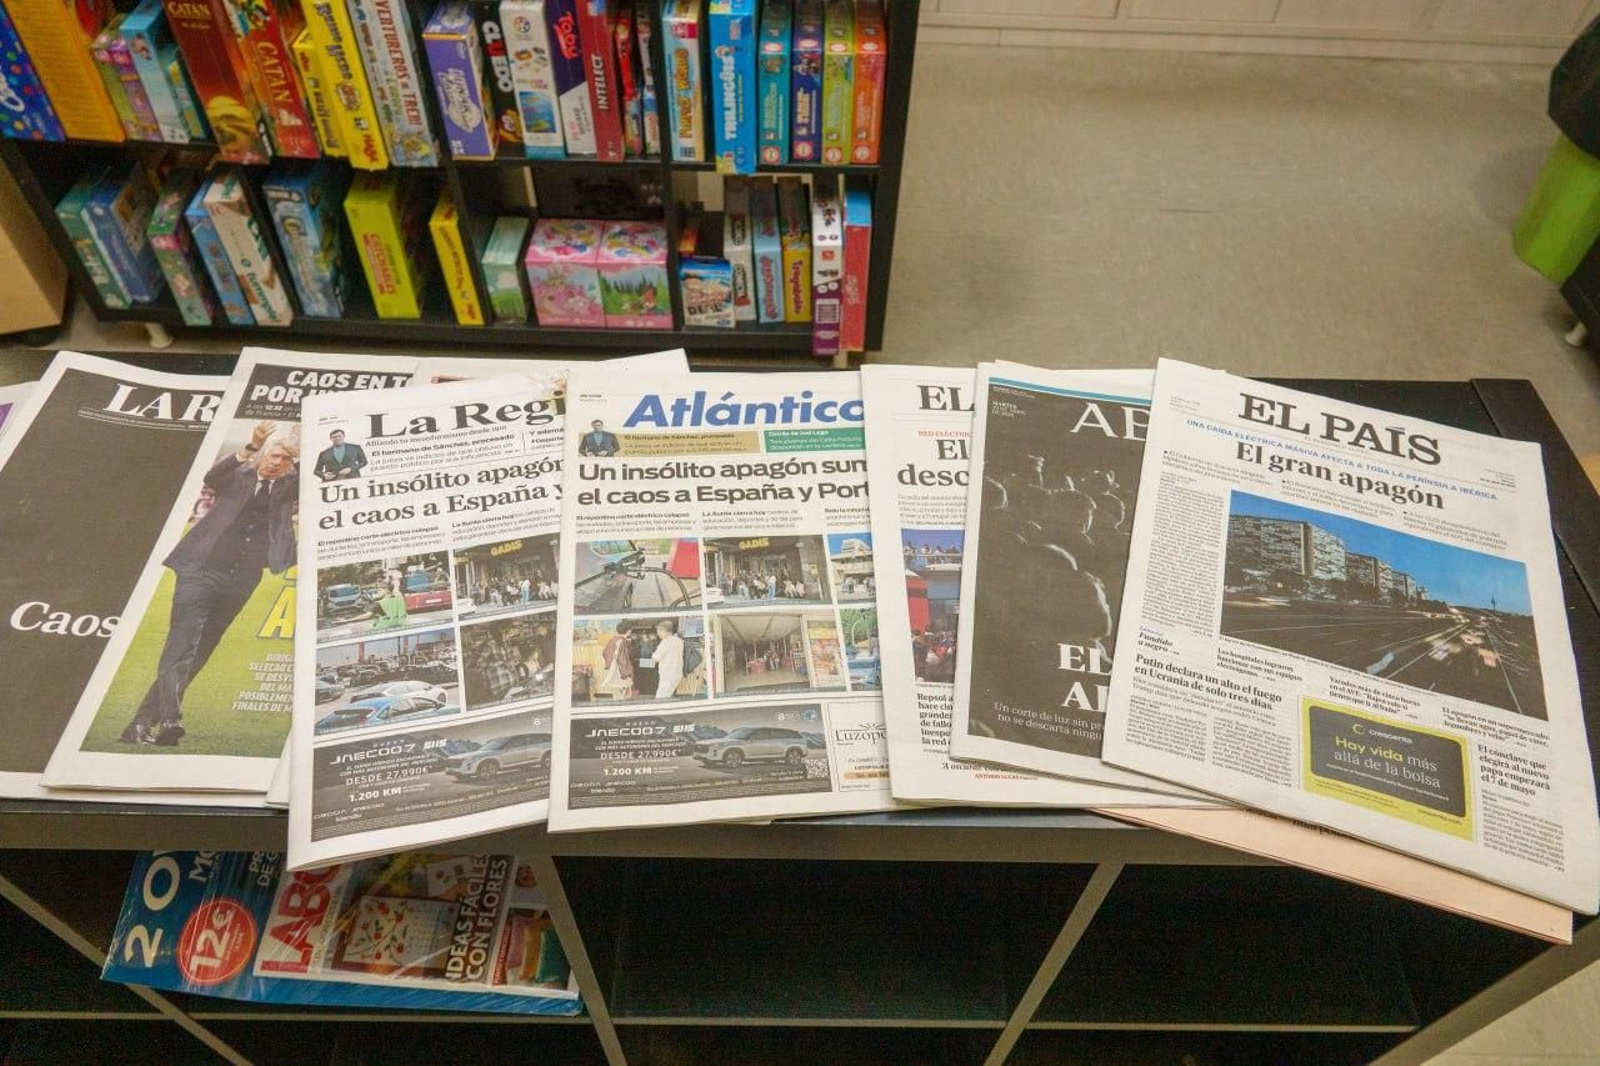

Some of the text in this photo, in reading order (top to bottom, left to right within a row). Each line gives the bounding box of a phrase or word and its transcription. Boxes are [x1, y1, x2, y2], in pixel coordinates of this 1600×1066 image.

[168, 2, 211, 16] CATAN
[482, 20, 514, 92] CLUEDO
[256, 41, 293, 103] CATAN
[591, 53, 609, 110] INTELECT
[286, 370, 349, 388] CAOS
[354, 374, 386, 389] EN
[102, 383, 172, 422] LA
[250, 384, 302, 403] POR
[917, 384, 975, 412] EL
[364, 413, 440, 439] La
[1238, 393, 1441, 466] EL PAÍS
[935, 439, 970, 460] El
[1186, 418, 1206, 430] UNA
[1206, 424, 1233, 437] CAÍDA
[1234, 432, 1285, 451] ELÉCTRICA
[1284, 443, 1320, 458] MASIVA
[1320, 452, 1355, 467] AFECTA
[1366, 464, 1390, 475] TODA
[1405, 474, 1457, 491] PENÍNSULA
[1459, 485, 1498, 501] IBÉRICA
[579, 464, 617, 481] Un
[621, 461, 716, 481] insólito
[720, 457, 817, 480] apagón
[1236, 441, 1262, 465] El
[1268, 454, 1333, 482] gran
[1339, 470, 1445, 510] apagón
[319, 484, 361, 504] Un
[366, 472, 471, 499] insólito
[577, 483, 813, 506] el caos a España y
[318, 509, 344, 530] el
[352, 505, 416, 526] caos
[423, 502, 441, 517] a
[446, 484, 550, 514] España
[490, 539, 523, 557] GADIS
[739, 537, 770, 550] GADIS
[10, 601, 120, 638] Caos
[1056, 642, 1112, 676] EL
[1134, 666, 1147, 676] en
[1149, 668, 1190, 688] Ucrania
[1190, 680, 1204, 692] de
[1205, 686, 1227, 698] solo
[1229, 692, 1249, 704] tres
[1136, 653, 1282, 703] Putin declara un alto el fuego
[917, 692, 947, 703] Repsol
[918, 701, 939, 710] hace
[920, 719, 931, 727] de
[994, 702, 1089, 729] Un corte de luz sin
[998, 713, 1011, 723] no
[1013, 717, 1025, 726] se
[1025, 717, 1070, 734] descarta
[931, 738, 947, 746] red
[1368, 729, 1413, 744] crescenta
[600, 751, 635, 761] DESDE
[1335, 736, 1439, 773] Hay vida más
[1477, 743, 1548, 771] El cónclave que
[1479, 755, 1550, 781] elegirá al nuevo
[345, 773, 383, 786] DESDE
[603, 766, 653, 776] 1.200 KM
[1333, 750, 1441, 789] allá de la bolsa
[1480, 765, 1551, 792] papa empezará
[349, 787, 402, 802] 1.200 KM
[1481, 773, 1489, 783] el
[1497, 778, 1510, 789] de
[1510, 782, 1536, 796] mayo
[445, 852, 491, 982] IDEAS FÁCILE
[466, 857, 508, 982] CON FLORES
[190, 905, 236, 974] 12€
